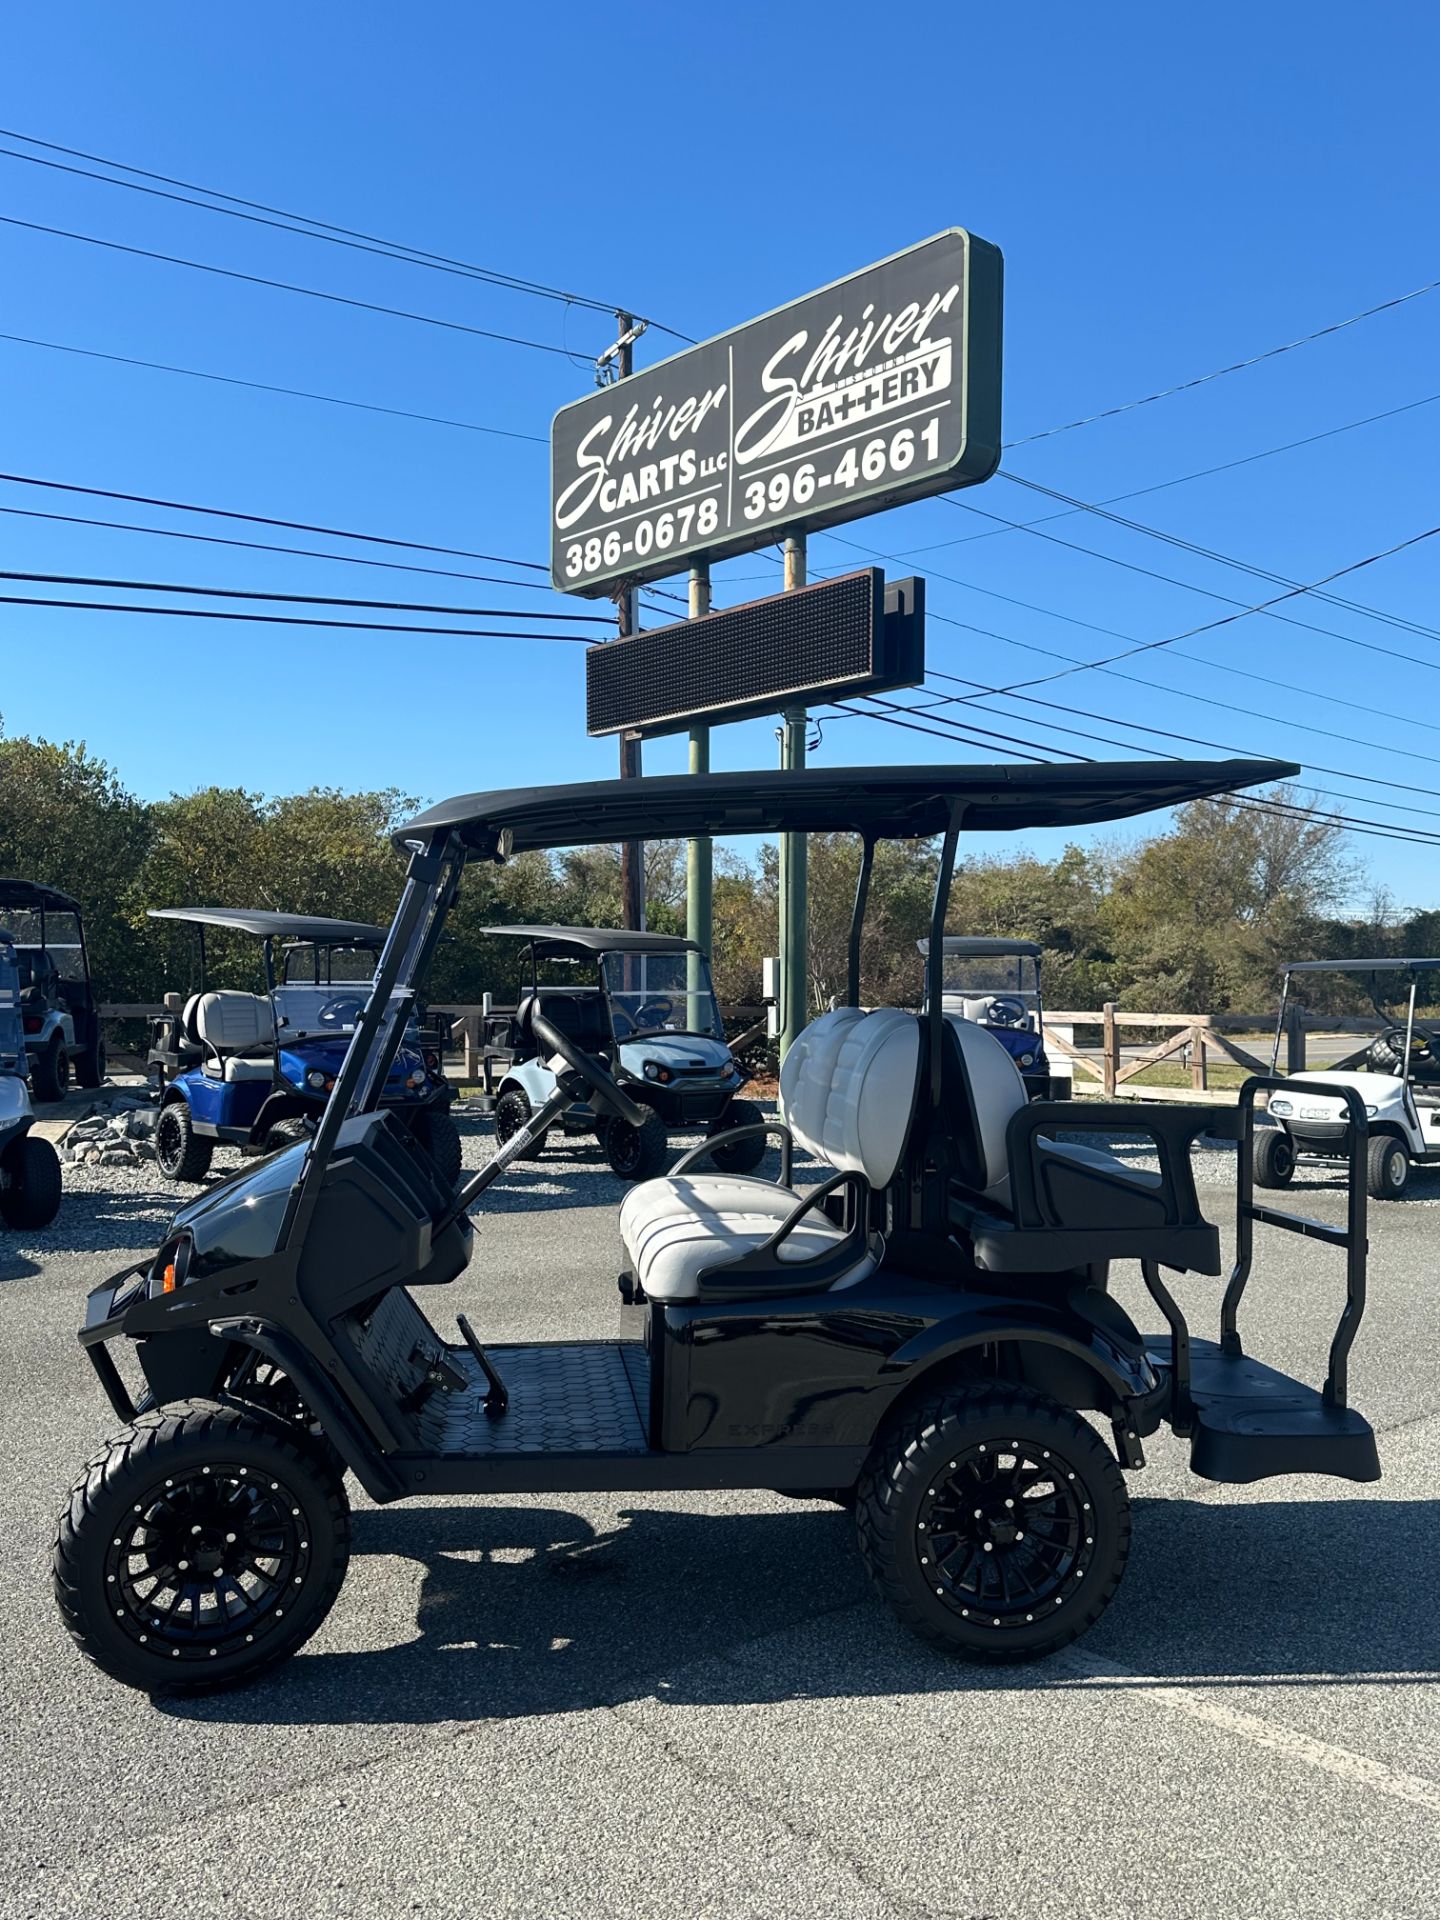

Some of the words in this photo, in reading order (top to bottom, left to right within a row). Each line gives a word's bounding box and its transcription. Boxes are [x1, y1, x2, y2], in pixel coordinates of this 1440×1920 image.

[734, 284, 960, 465] Shiver
[556, 384, 728, 530] Shiver
[600, 449, 697, 513] CARTS
[700, 452, 728, 478] LLC
[744, 417, 939, 520] 396-4661
[565, 498, 719, 578] 386-0678
[728, 1423, 834, 1437] EXPRESS
